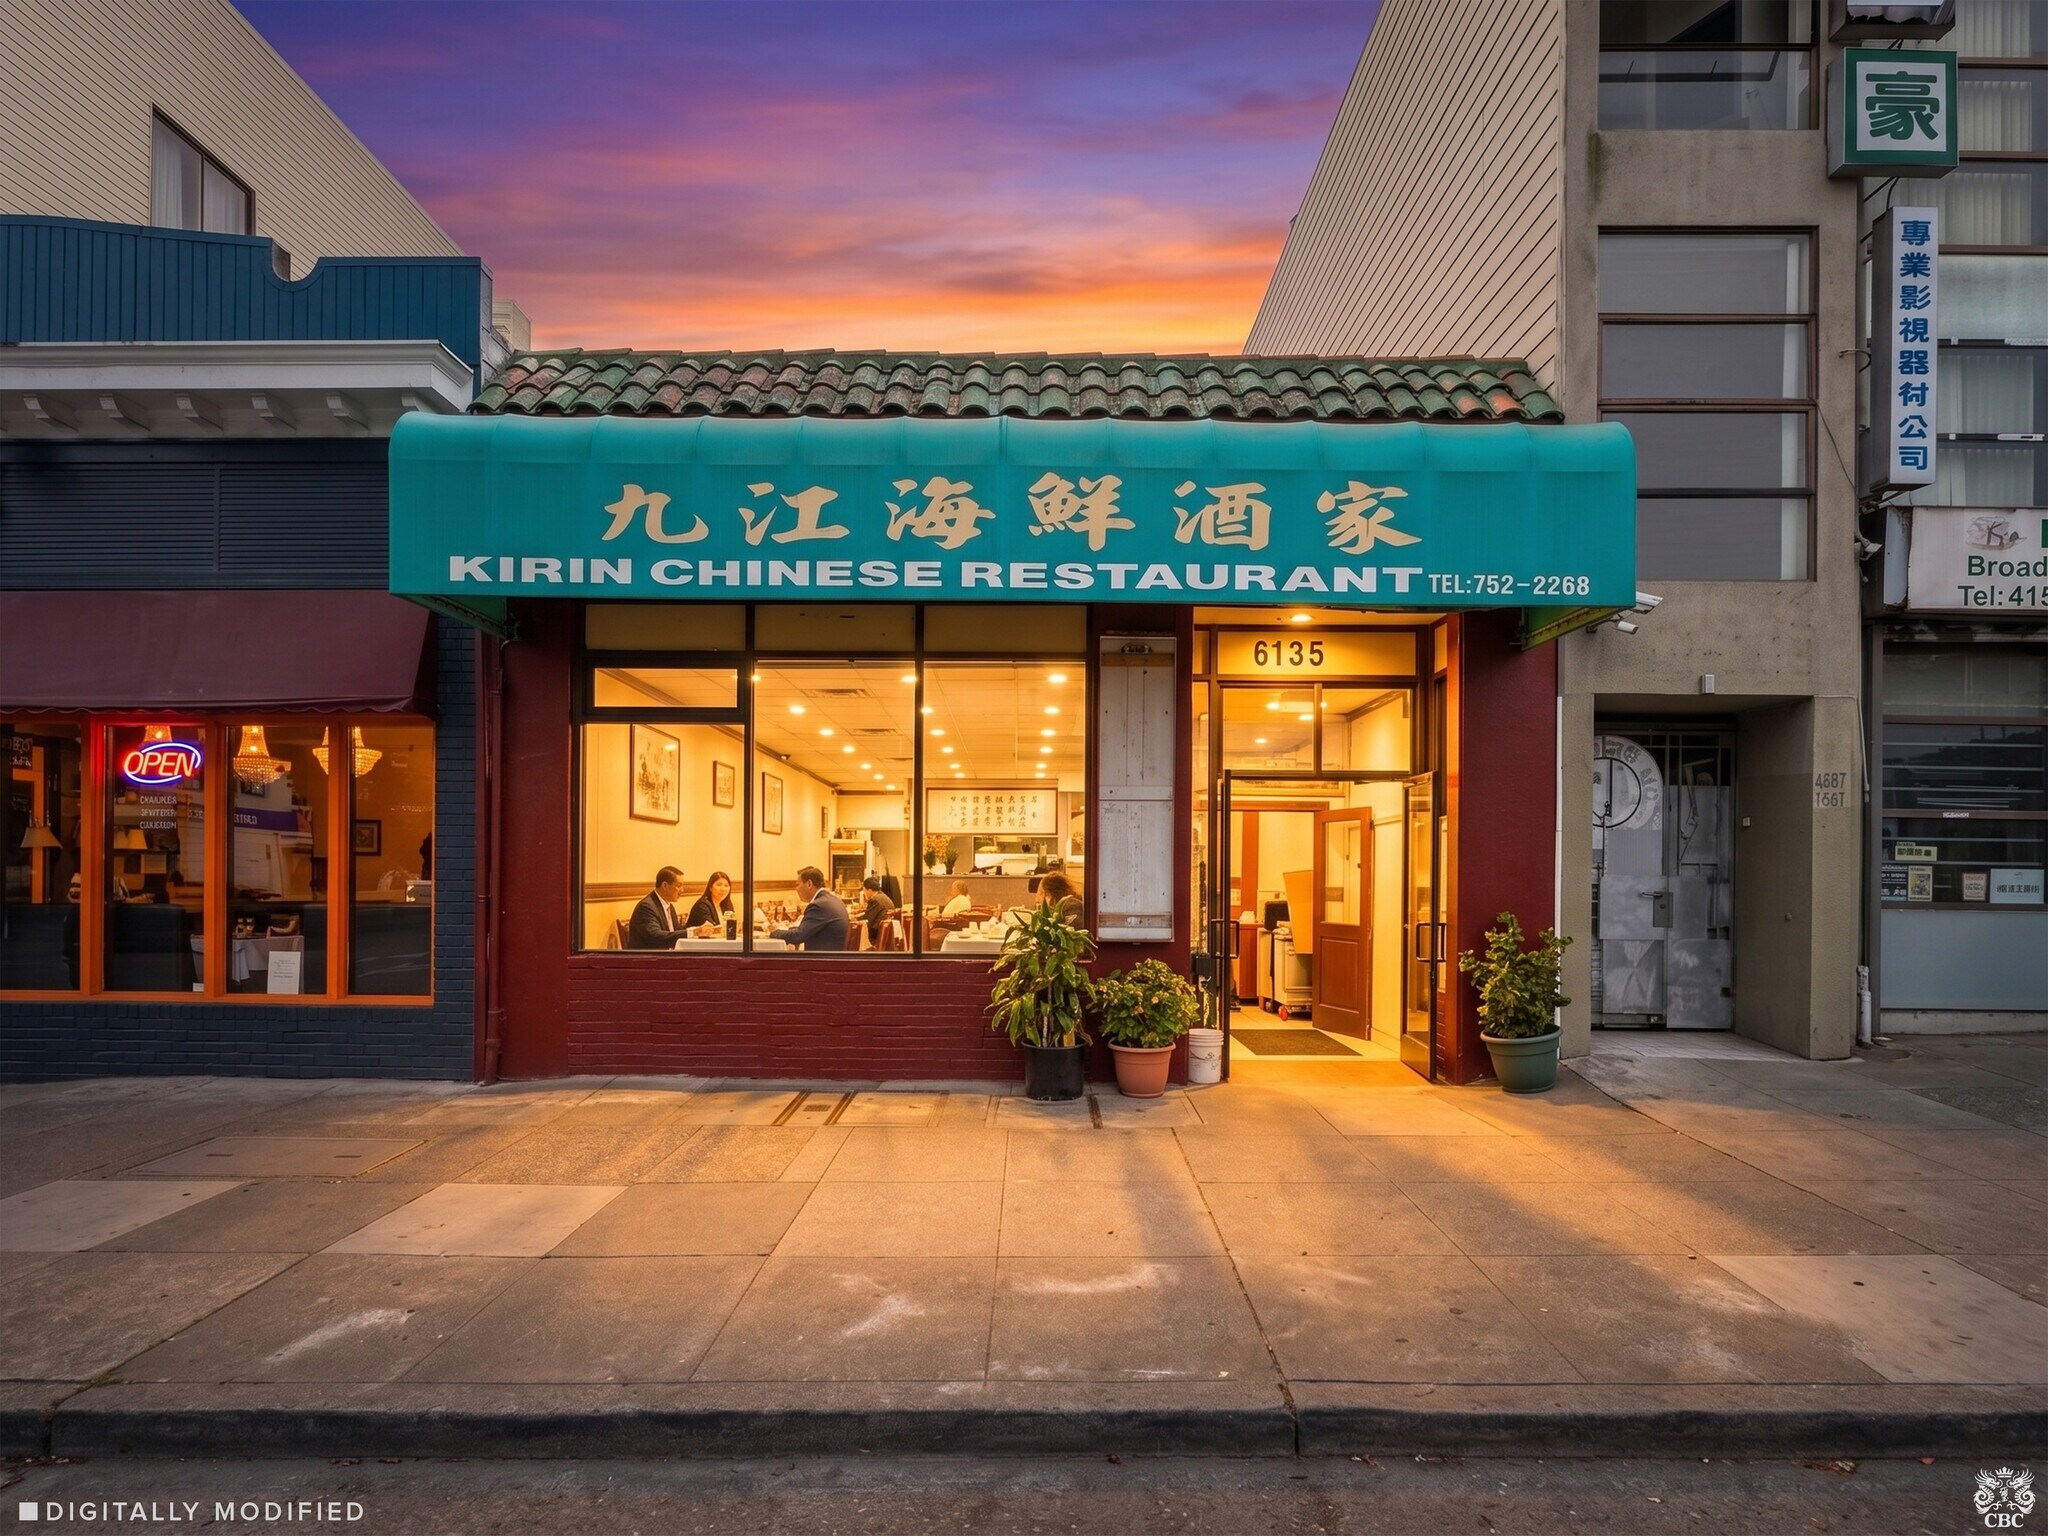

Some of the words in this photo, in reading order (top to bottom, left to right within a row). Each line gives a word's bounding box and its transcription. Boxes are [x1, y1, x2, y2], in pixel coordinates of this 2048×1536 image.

[1865, 70, 1940, 140] 豪
[601, 471, 1422, 553] 九江海鮮酒家
[449, 555, 632, 584] KIRIN
[650, 559, 942, 587] CHINESE
[961, 561, 1423, 593] RESTAURANT
[1967, 555, 2048, 577] Broad
[1253, 640, 1325, 667] 6135
[124, 751, 196, 777] OPEN
